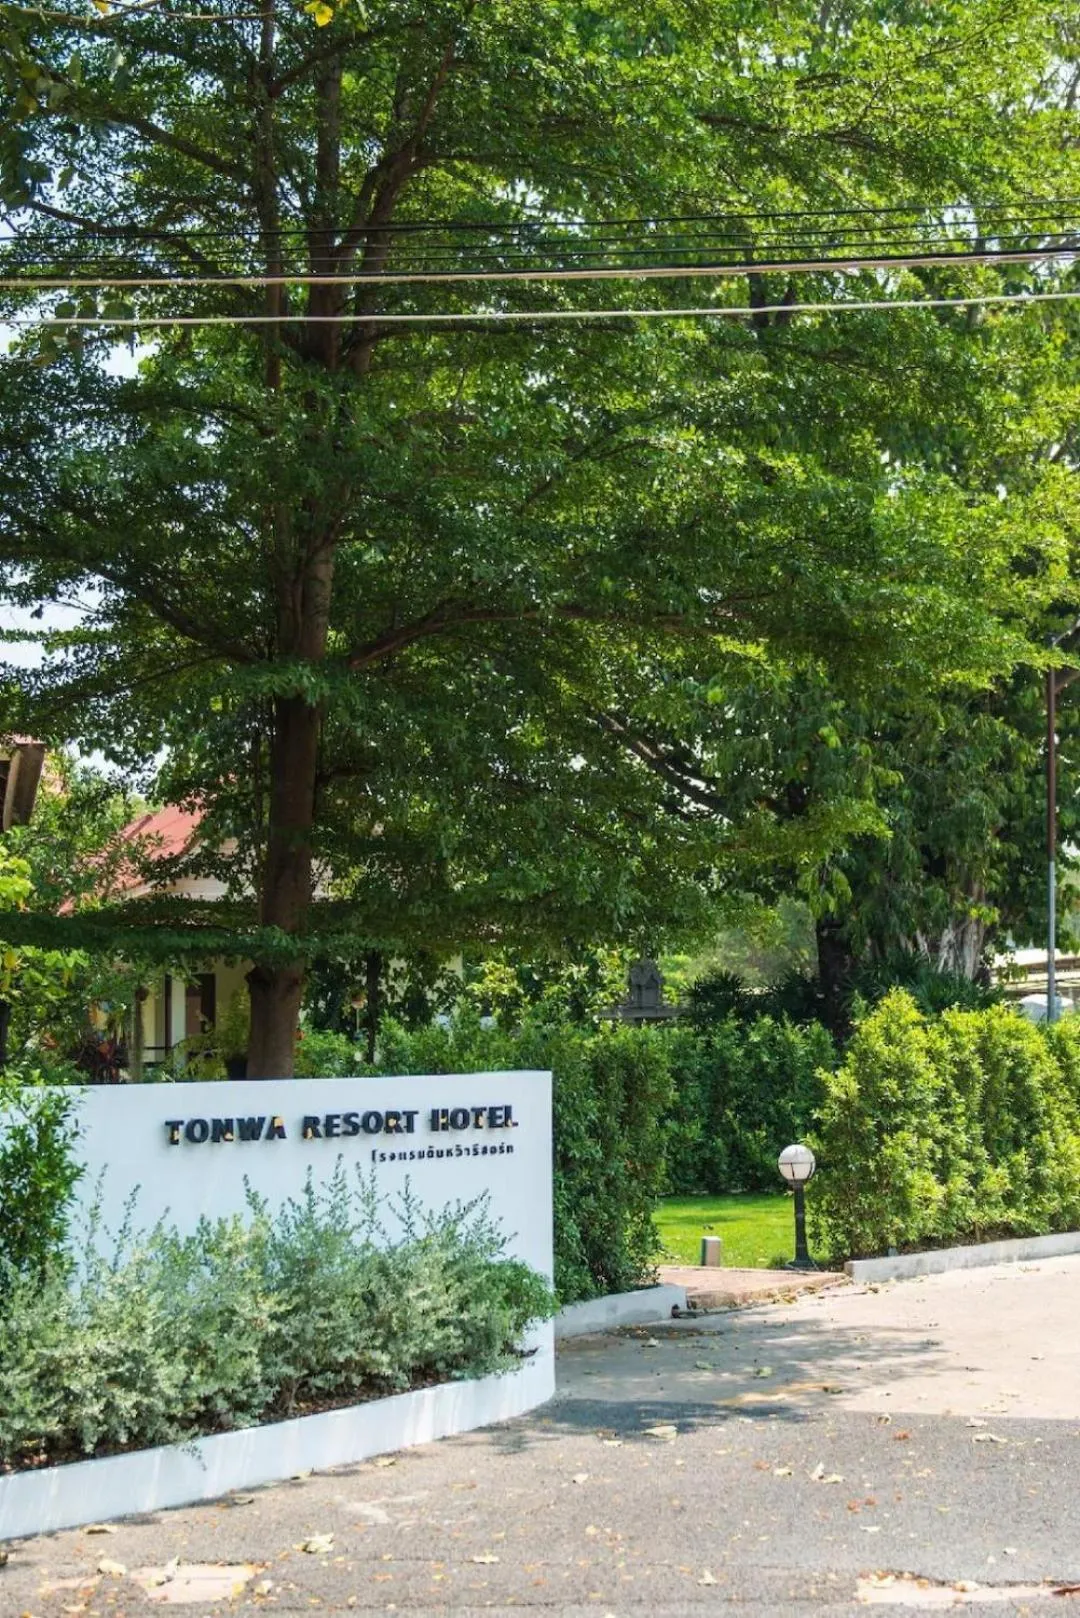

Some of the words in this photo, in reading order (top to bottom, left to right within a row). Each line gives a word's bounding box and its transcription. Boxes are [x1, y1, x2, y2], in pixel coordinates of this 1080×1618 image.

[165, 1116, 287, 1145] TONWA
[303, 1109, 419, 1140] RESORT
[430, 1104, 519, 1132] HOTEL
